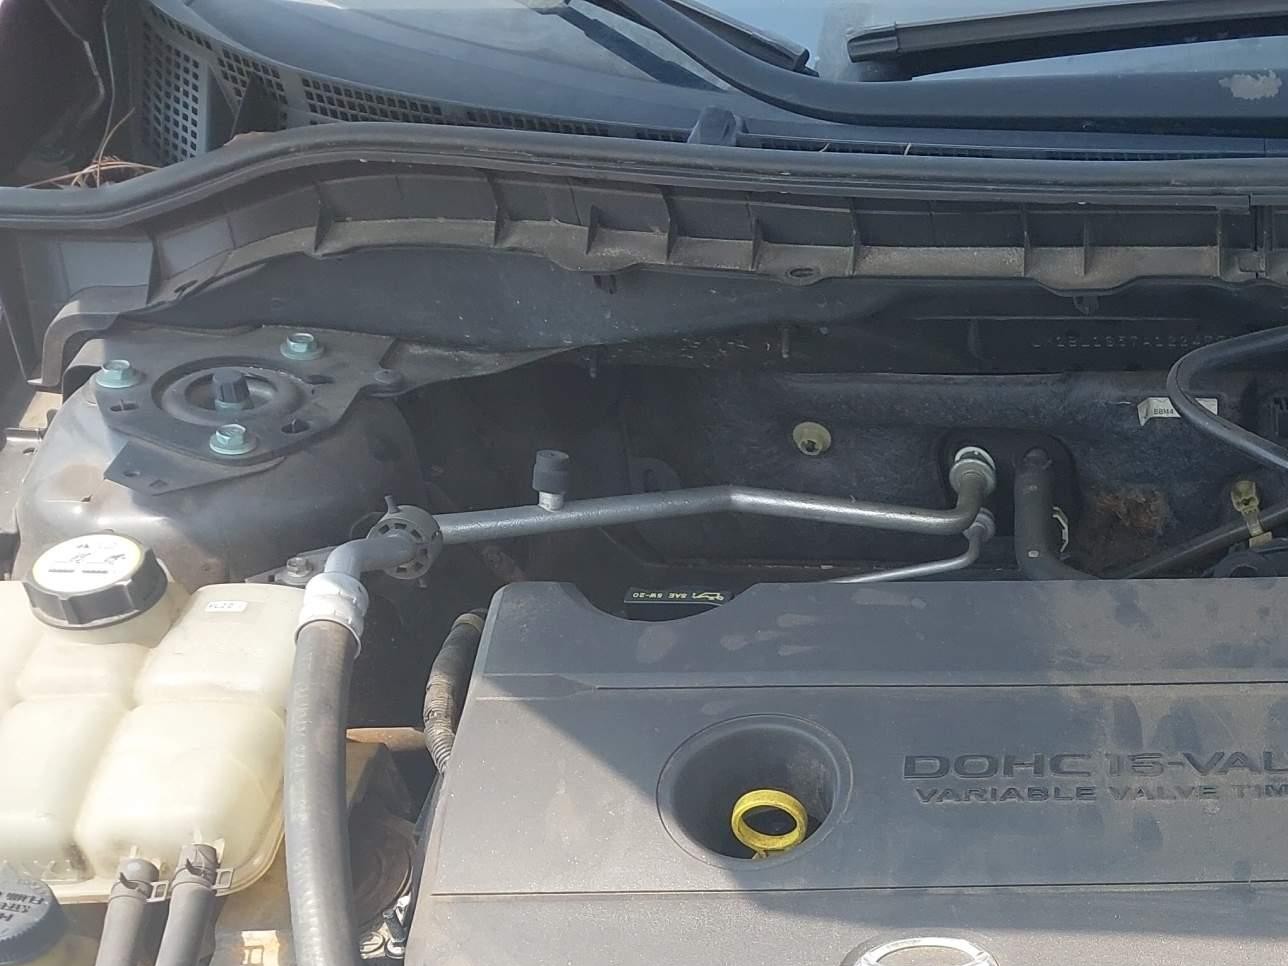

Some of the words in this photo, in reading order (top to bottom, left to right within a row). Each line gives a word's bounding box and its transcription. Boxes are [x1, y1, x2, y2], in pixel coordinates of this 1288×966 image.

[903, 751, 1092, 779] DOHC
[915, 785, 1097, 803] VARIABLE
[1108, 783, 1218, 801] VALVE
